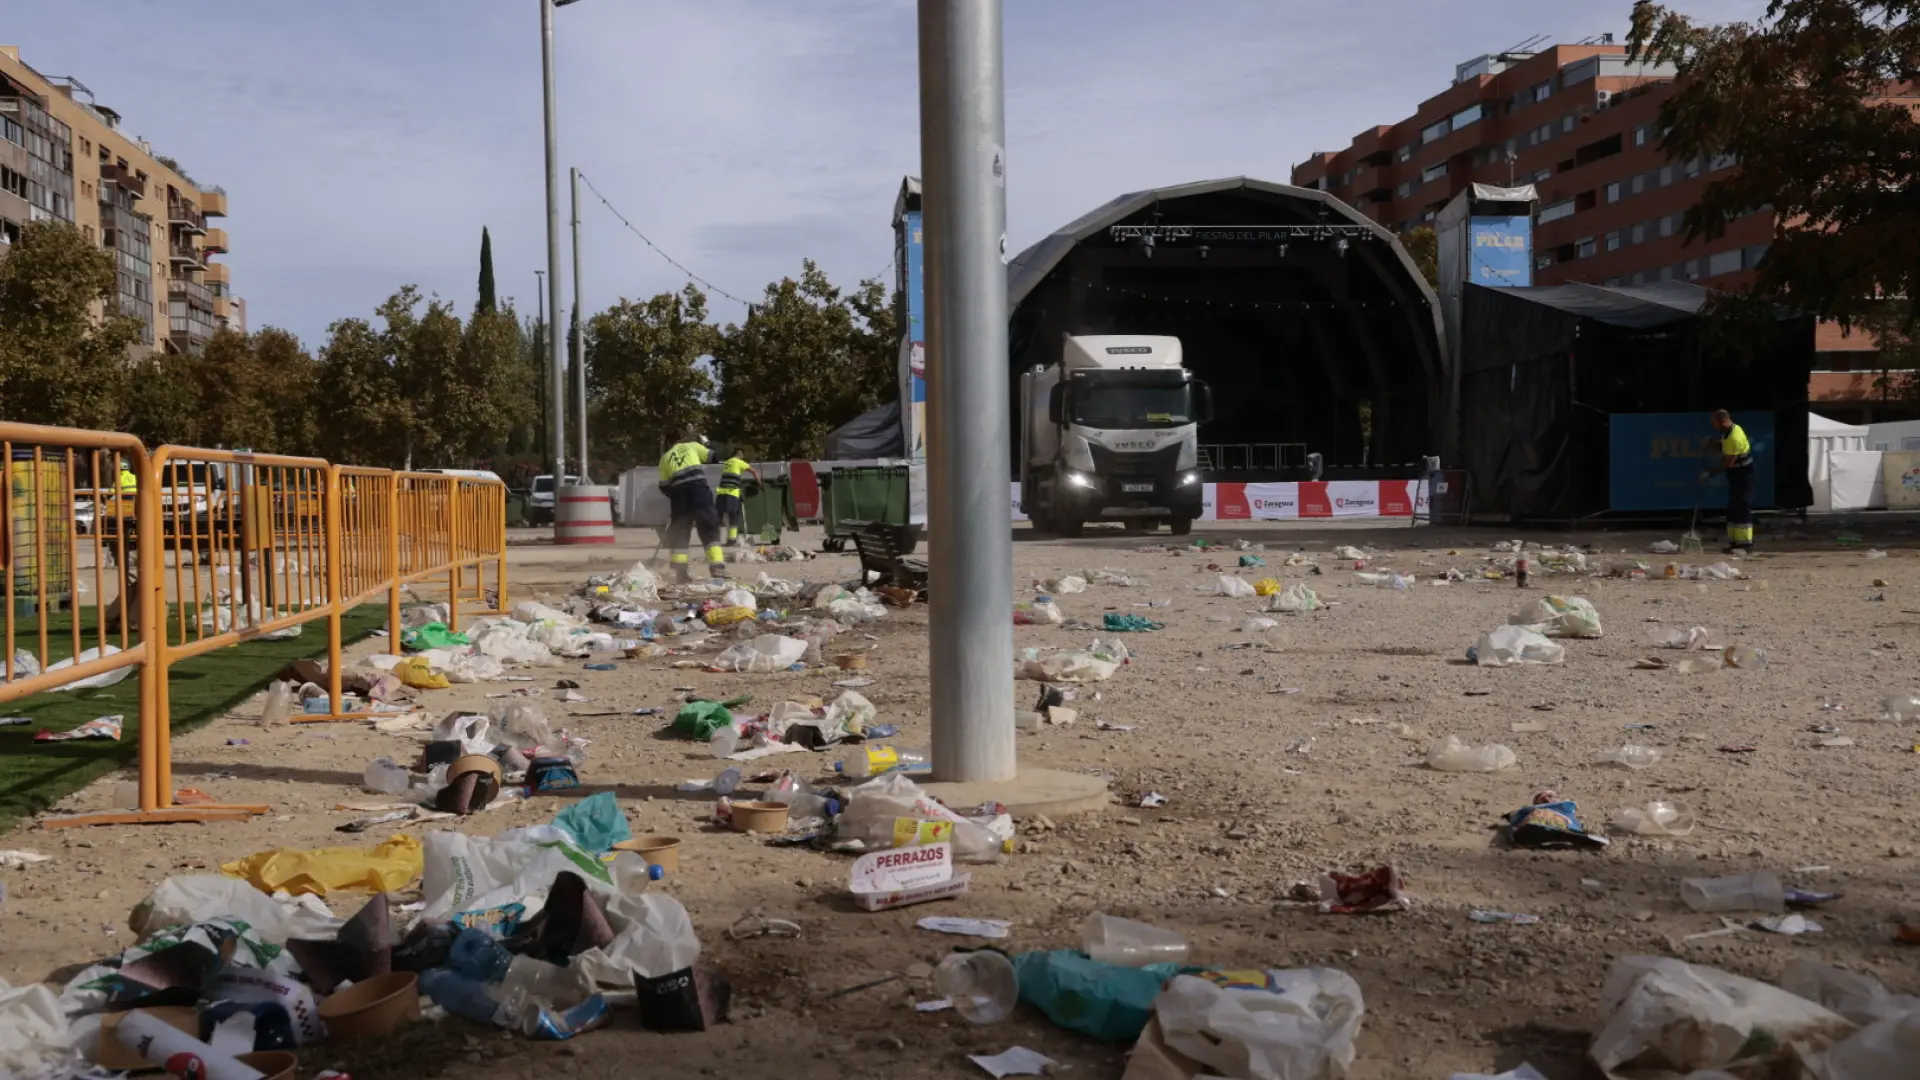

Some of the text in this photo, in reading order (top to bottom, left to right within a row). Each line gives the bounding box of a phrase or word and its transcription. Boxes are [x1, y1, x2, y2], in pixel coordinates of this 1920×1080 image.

[1195, 231, 1287, 240] FIESTAS DEL PILAR
[1115, 441, 1156, 449] IVECO
[1264, 500, 1294, 509] Zaragoza
[1344, 499, 1375, 508] Zaragoza
[876, 847, 944, 869] PERRAZOS
